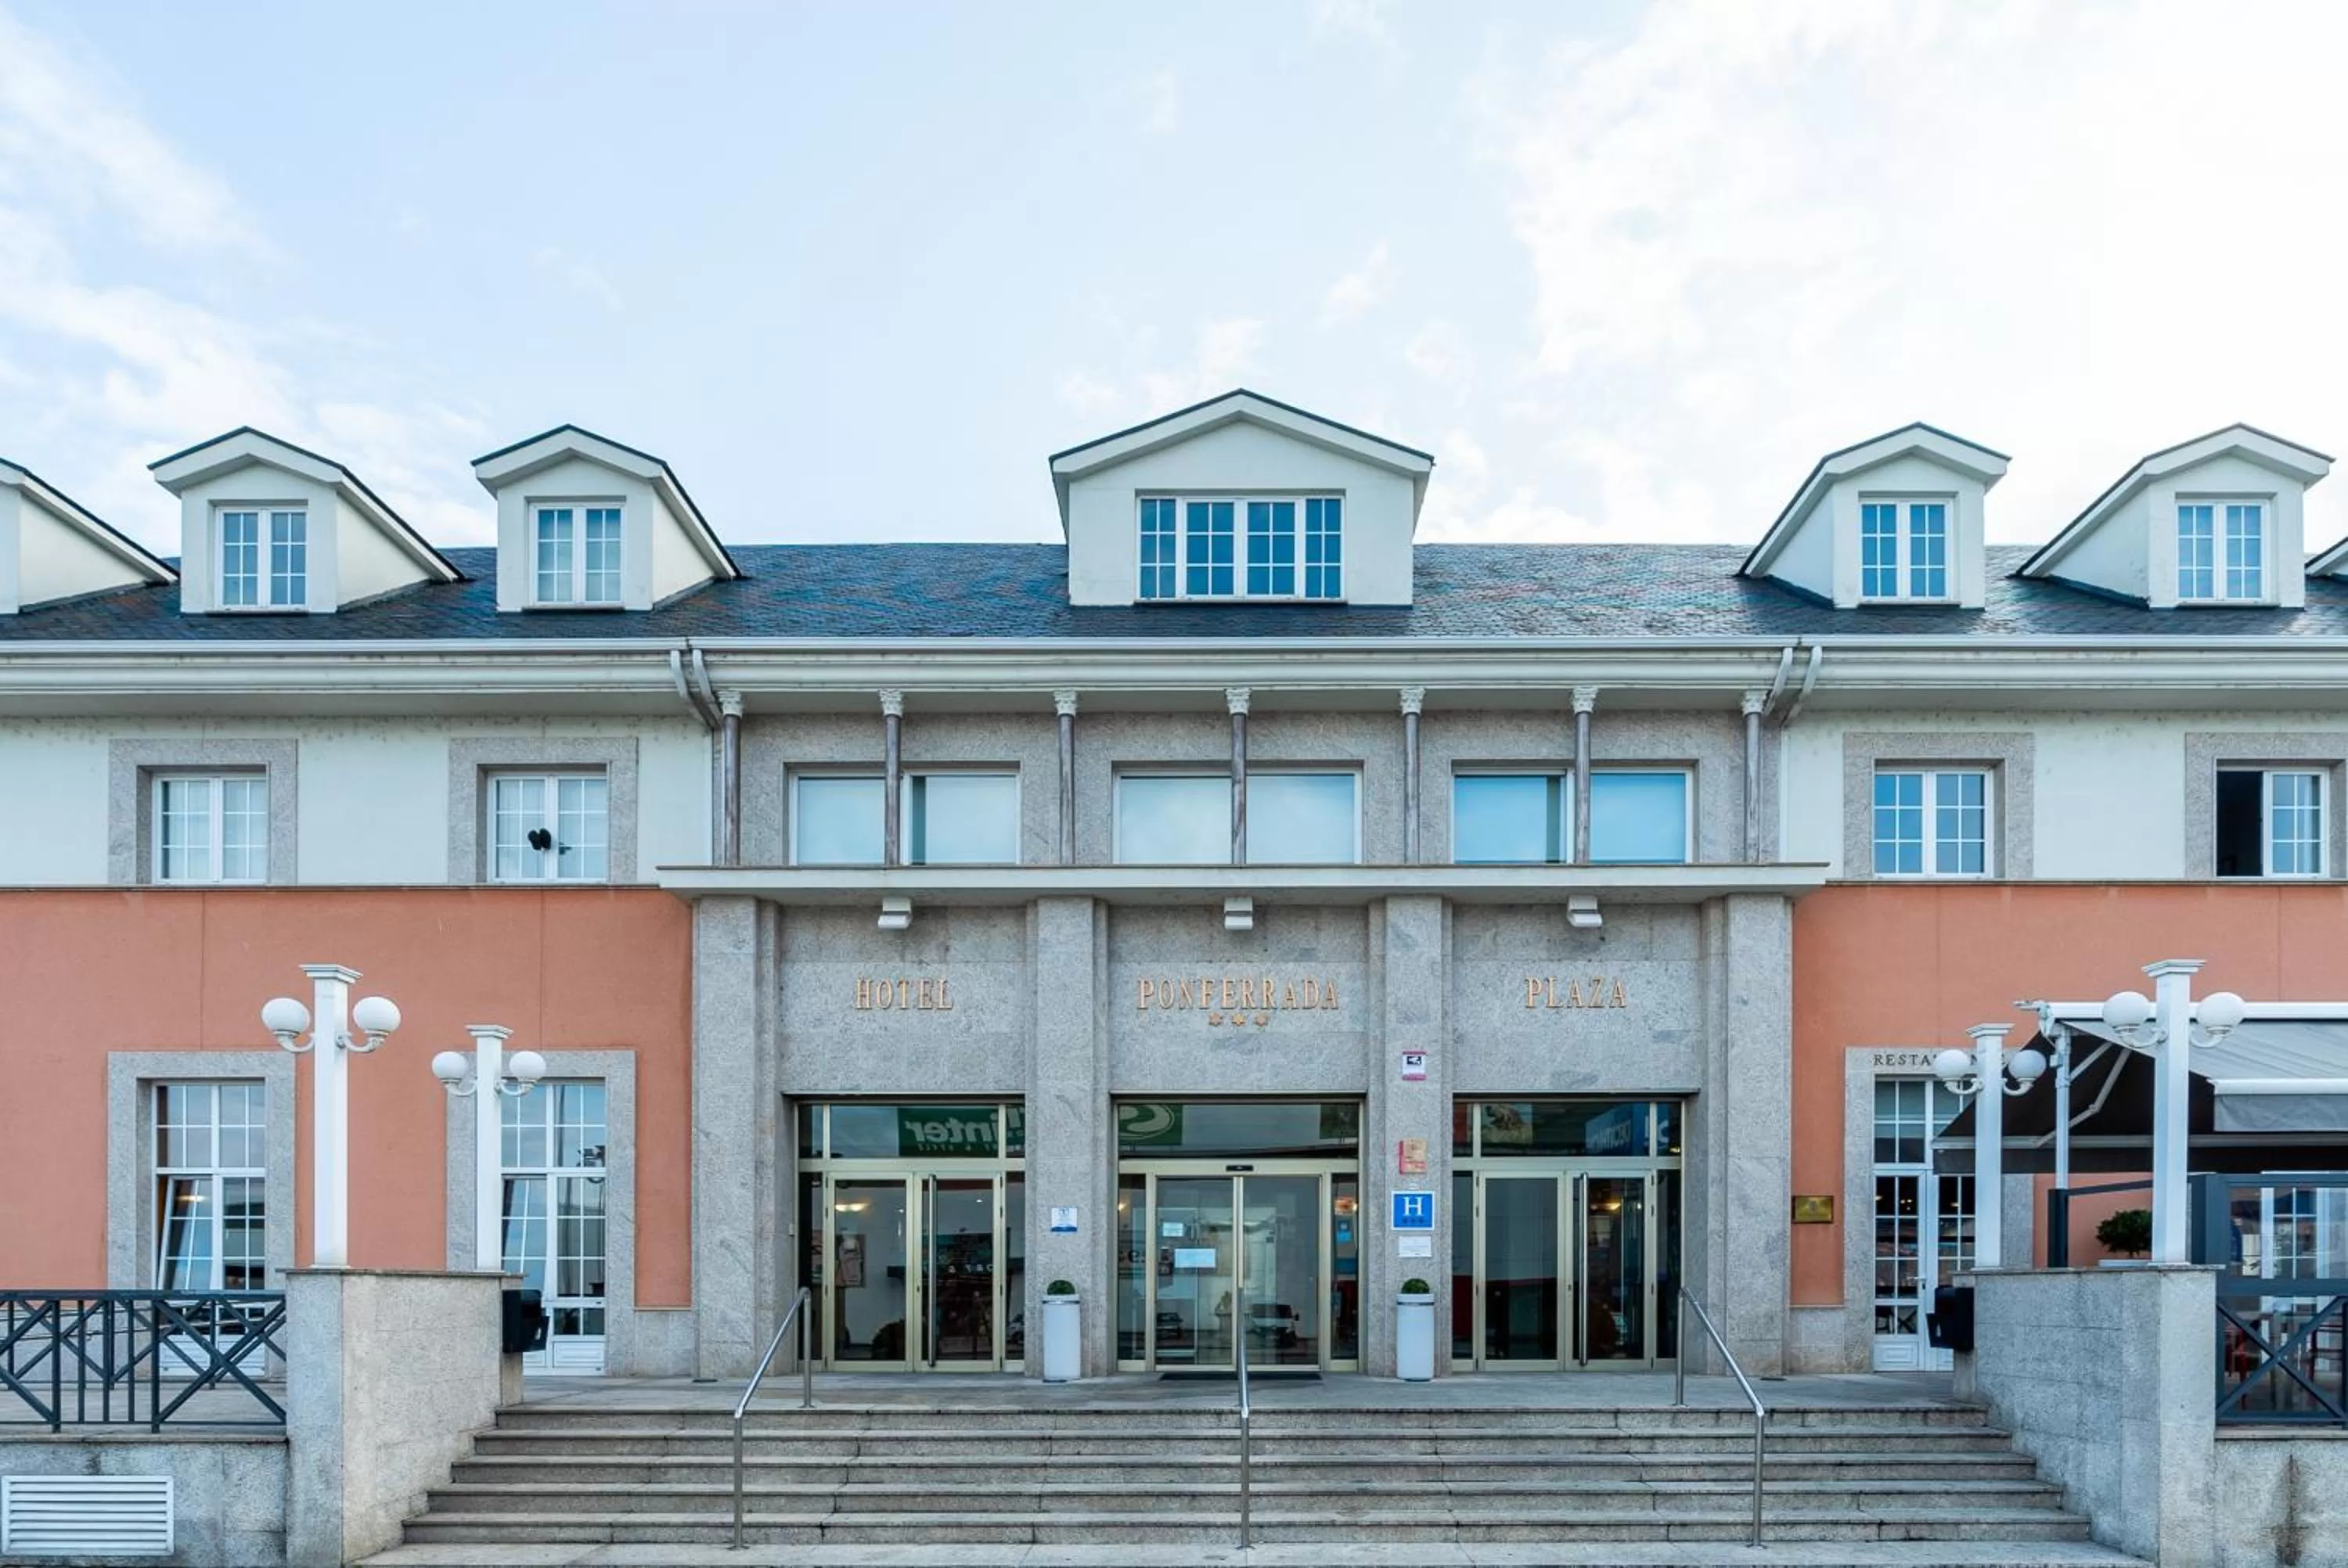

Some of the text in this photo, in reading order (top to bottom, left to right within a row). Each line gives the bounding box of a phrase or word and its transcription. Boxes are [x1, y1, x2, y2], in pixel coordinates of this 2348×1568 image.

[855, 976, 1627, 1010] HOTEL PONFERRADA PLAZA
[1403, 1196, 1424, 1217] H
